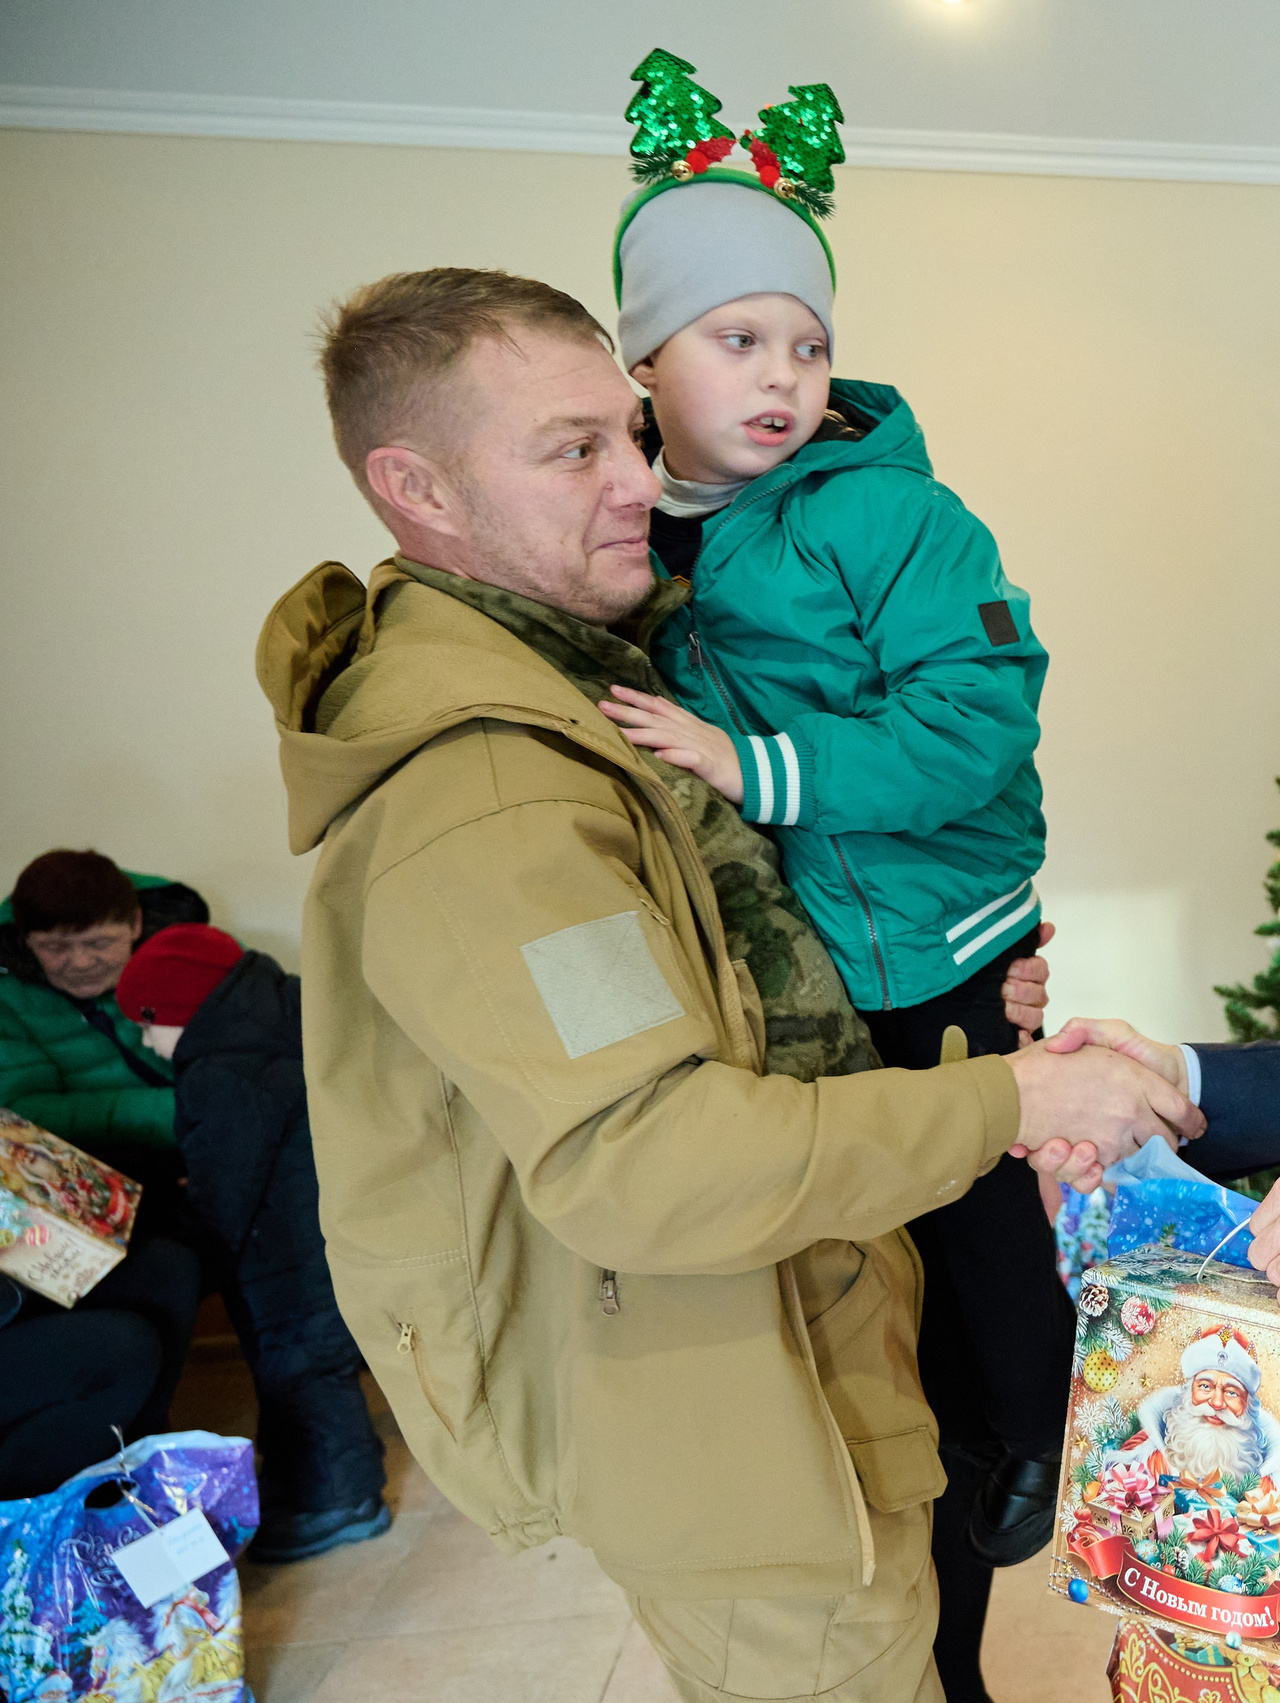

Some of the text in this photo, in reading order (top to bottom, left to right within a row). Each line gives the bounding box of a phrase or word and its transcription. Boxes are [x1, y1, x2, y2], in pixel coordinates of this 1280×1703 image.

[1124, 1567, 1275, 1629] С Новым годом!
